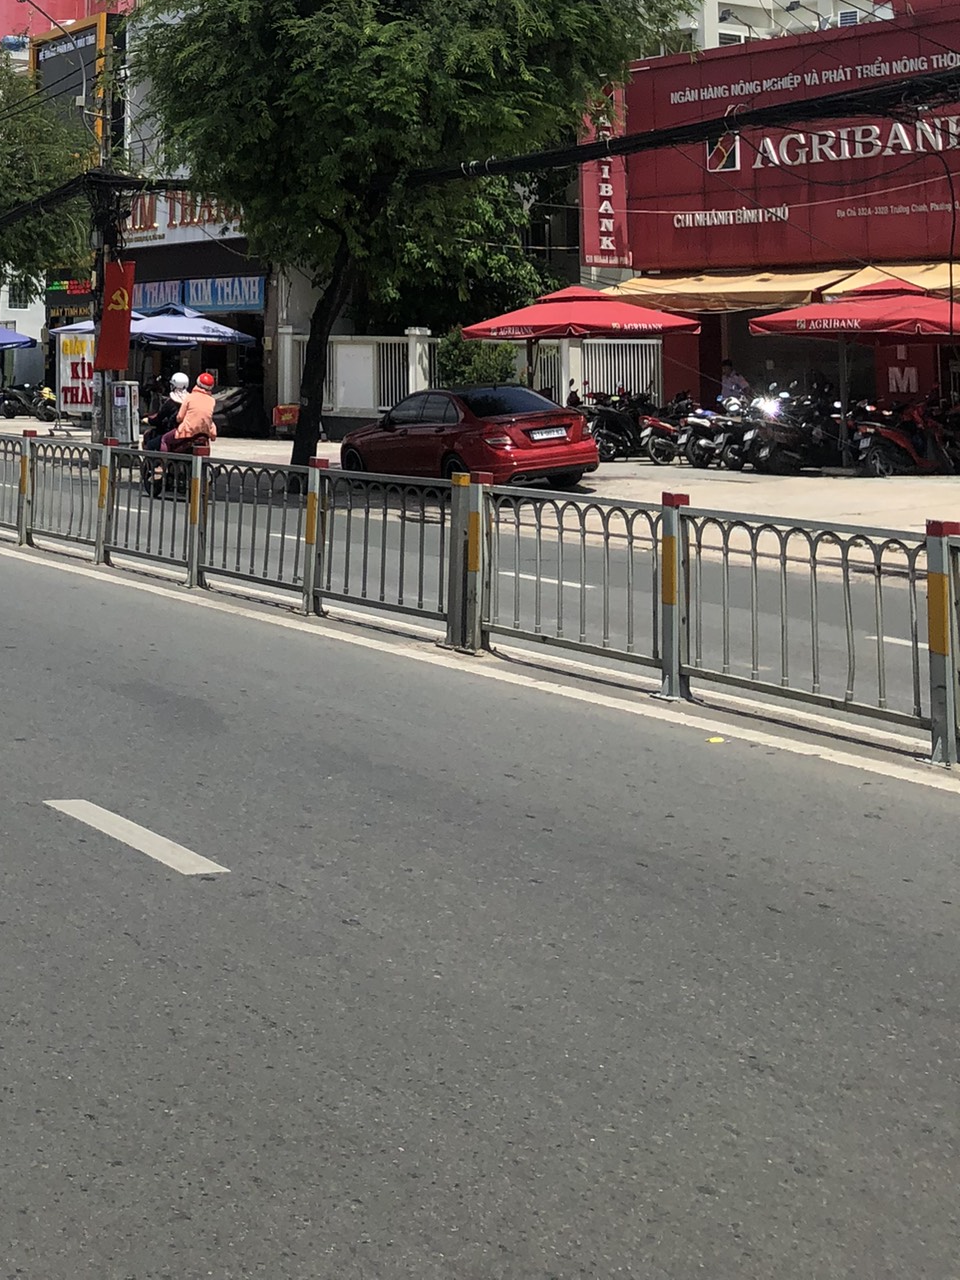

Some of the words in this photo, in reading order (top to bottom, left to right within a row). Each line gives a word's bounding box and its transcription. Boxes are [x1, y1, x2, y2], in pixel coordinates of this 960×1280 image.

[670, 87, 698, 104] NGÂN
[700, 84, 729, 100] HÀNG
[731, 80, 761, 97] NÔNG
[762, 72, 802, 92] NGHIỆP
[803, 69, 820, 86] VÀ
[822, 65, 853, 83] PHÁT
[855, 56, 890, 79] TRIỂN
[892, 56, 929, 74] NÔNG
[598, 114, 616, 250] AGIBANK
[674, 213, 693, 228] CHI
[694, 209, 734, 227] NHÁNH
[735, 206, 763, 224] BÌNH
[189, 279, 212, 306] KIM
[808, 319, 861, 329] AGRIBANK
